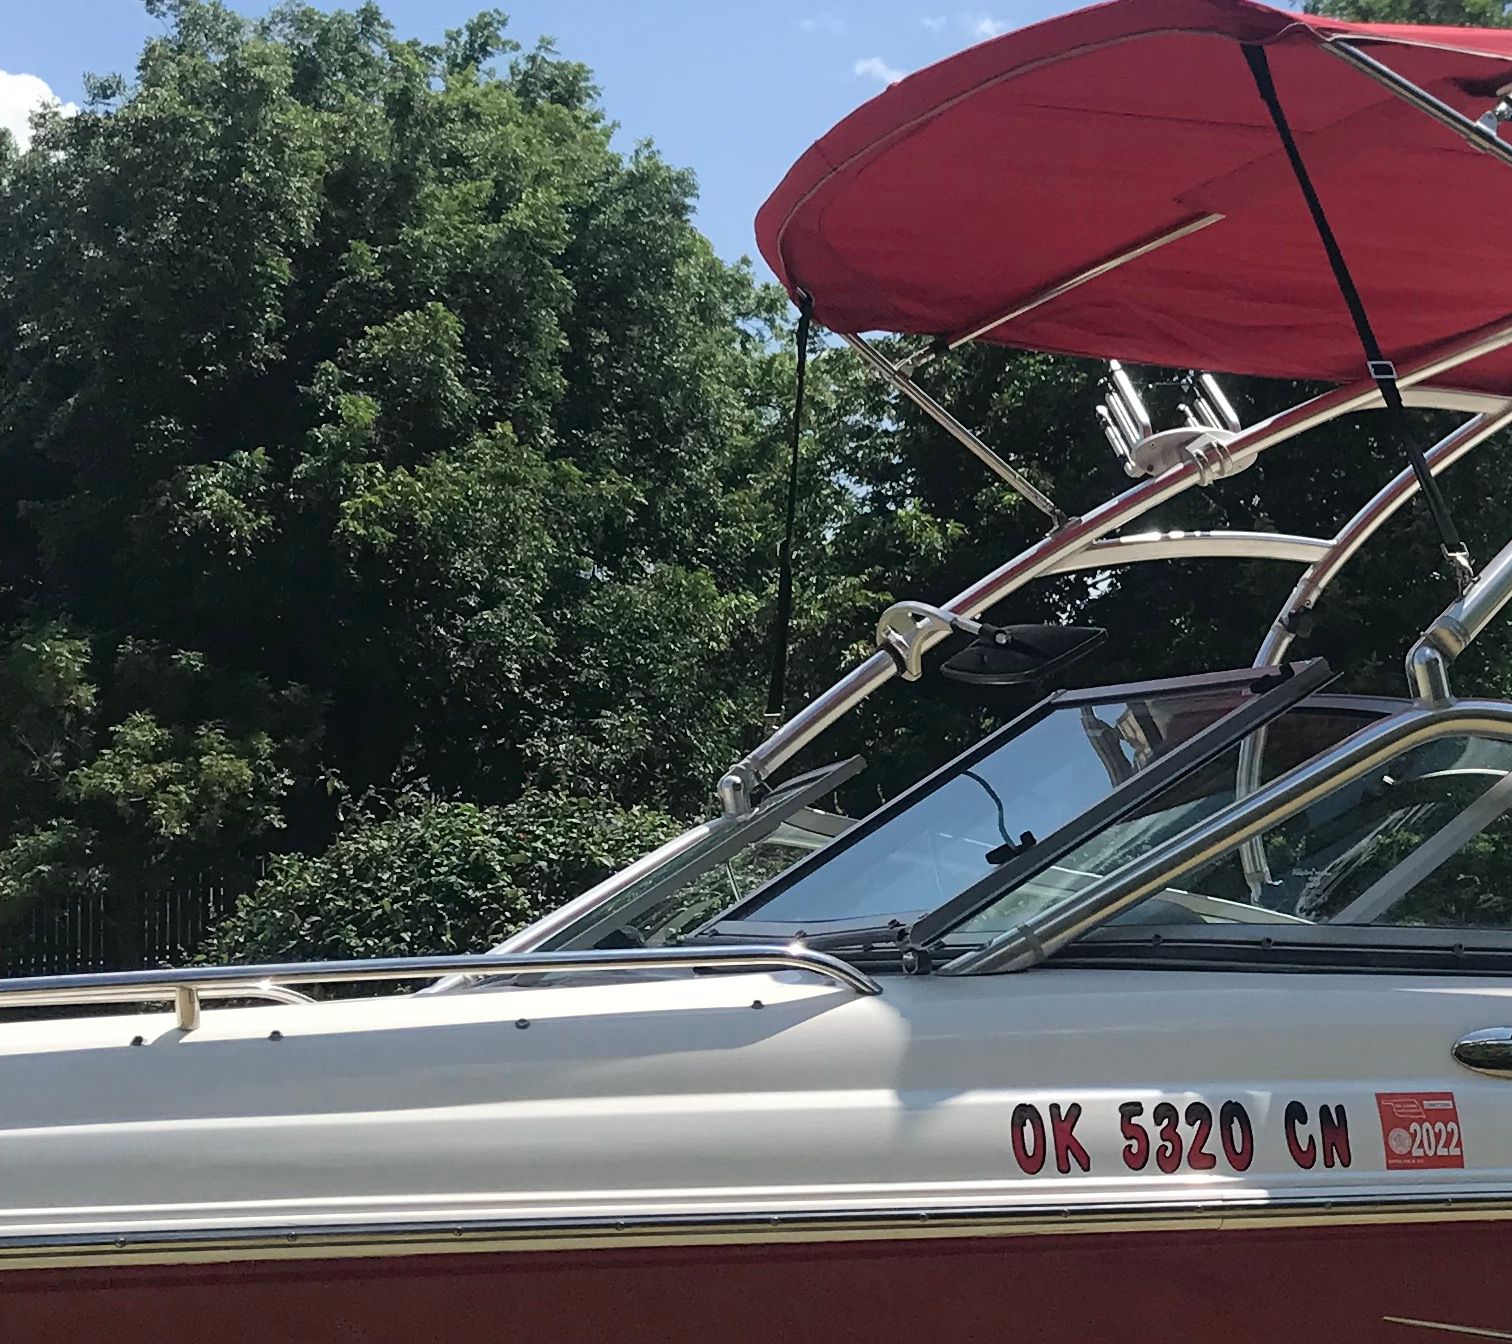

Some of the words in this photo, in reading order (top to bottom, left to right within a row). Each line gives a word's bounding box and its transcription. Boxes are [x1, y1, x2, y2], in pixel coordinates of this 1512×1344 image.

[1010, 1101, 1091, 1175] OK
[1118, 1099, 1255, 1174] 5320
[1284, 1100, 1352, 1169] CN
[1409, 1121, 1462, 1157] 2022
